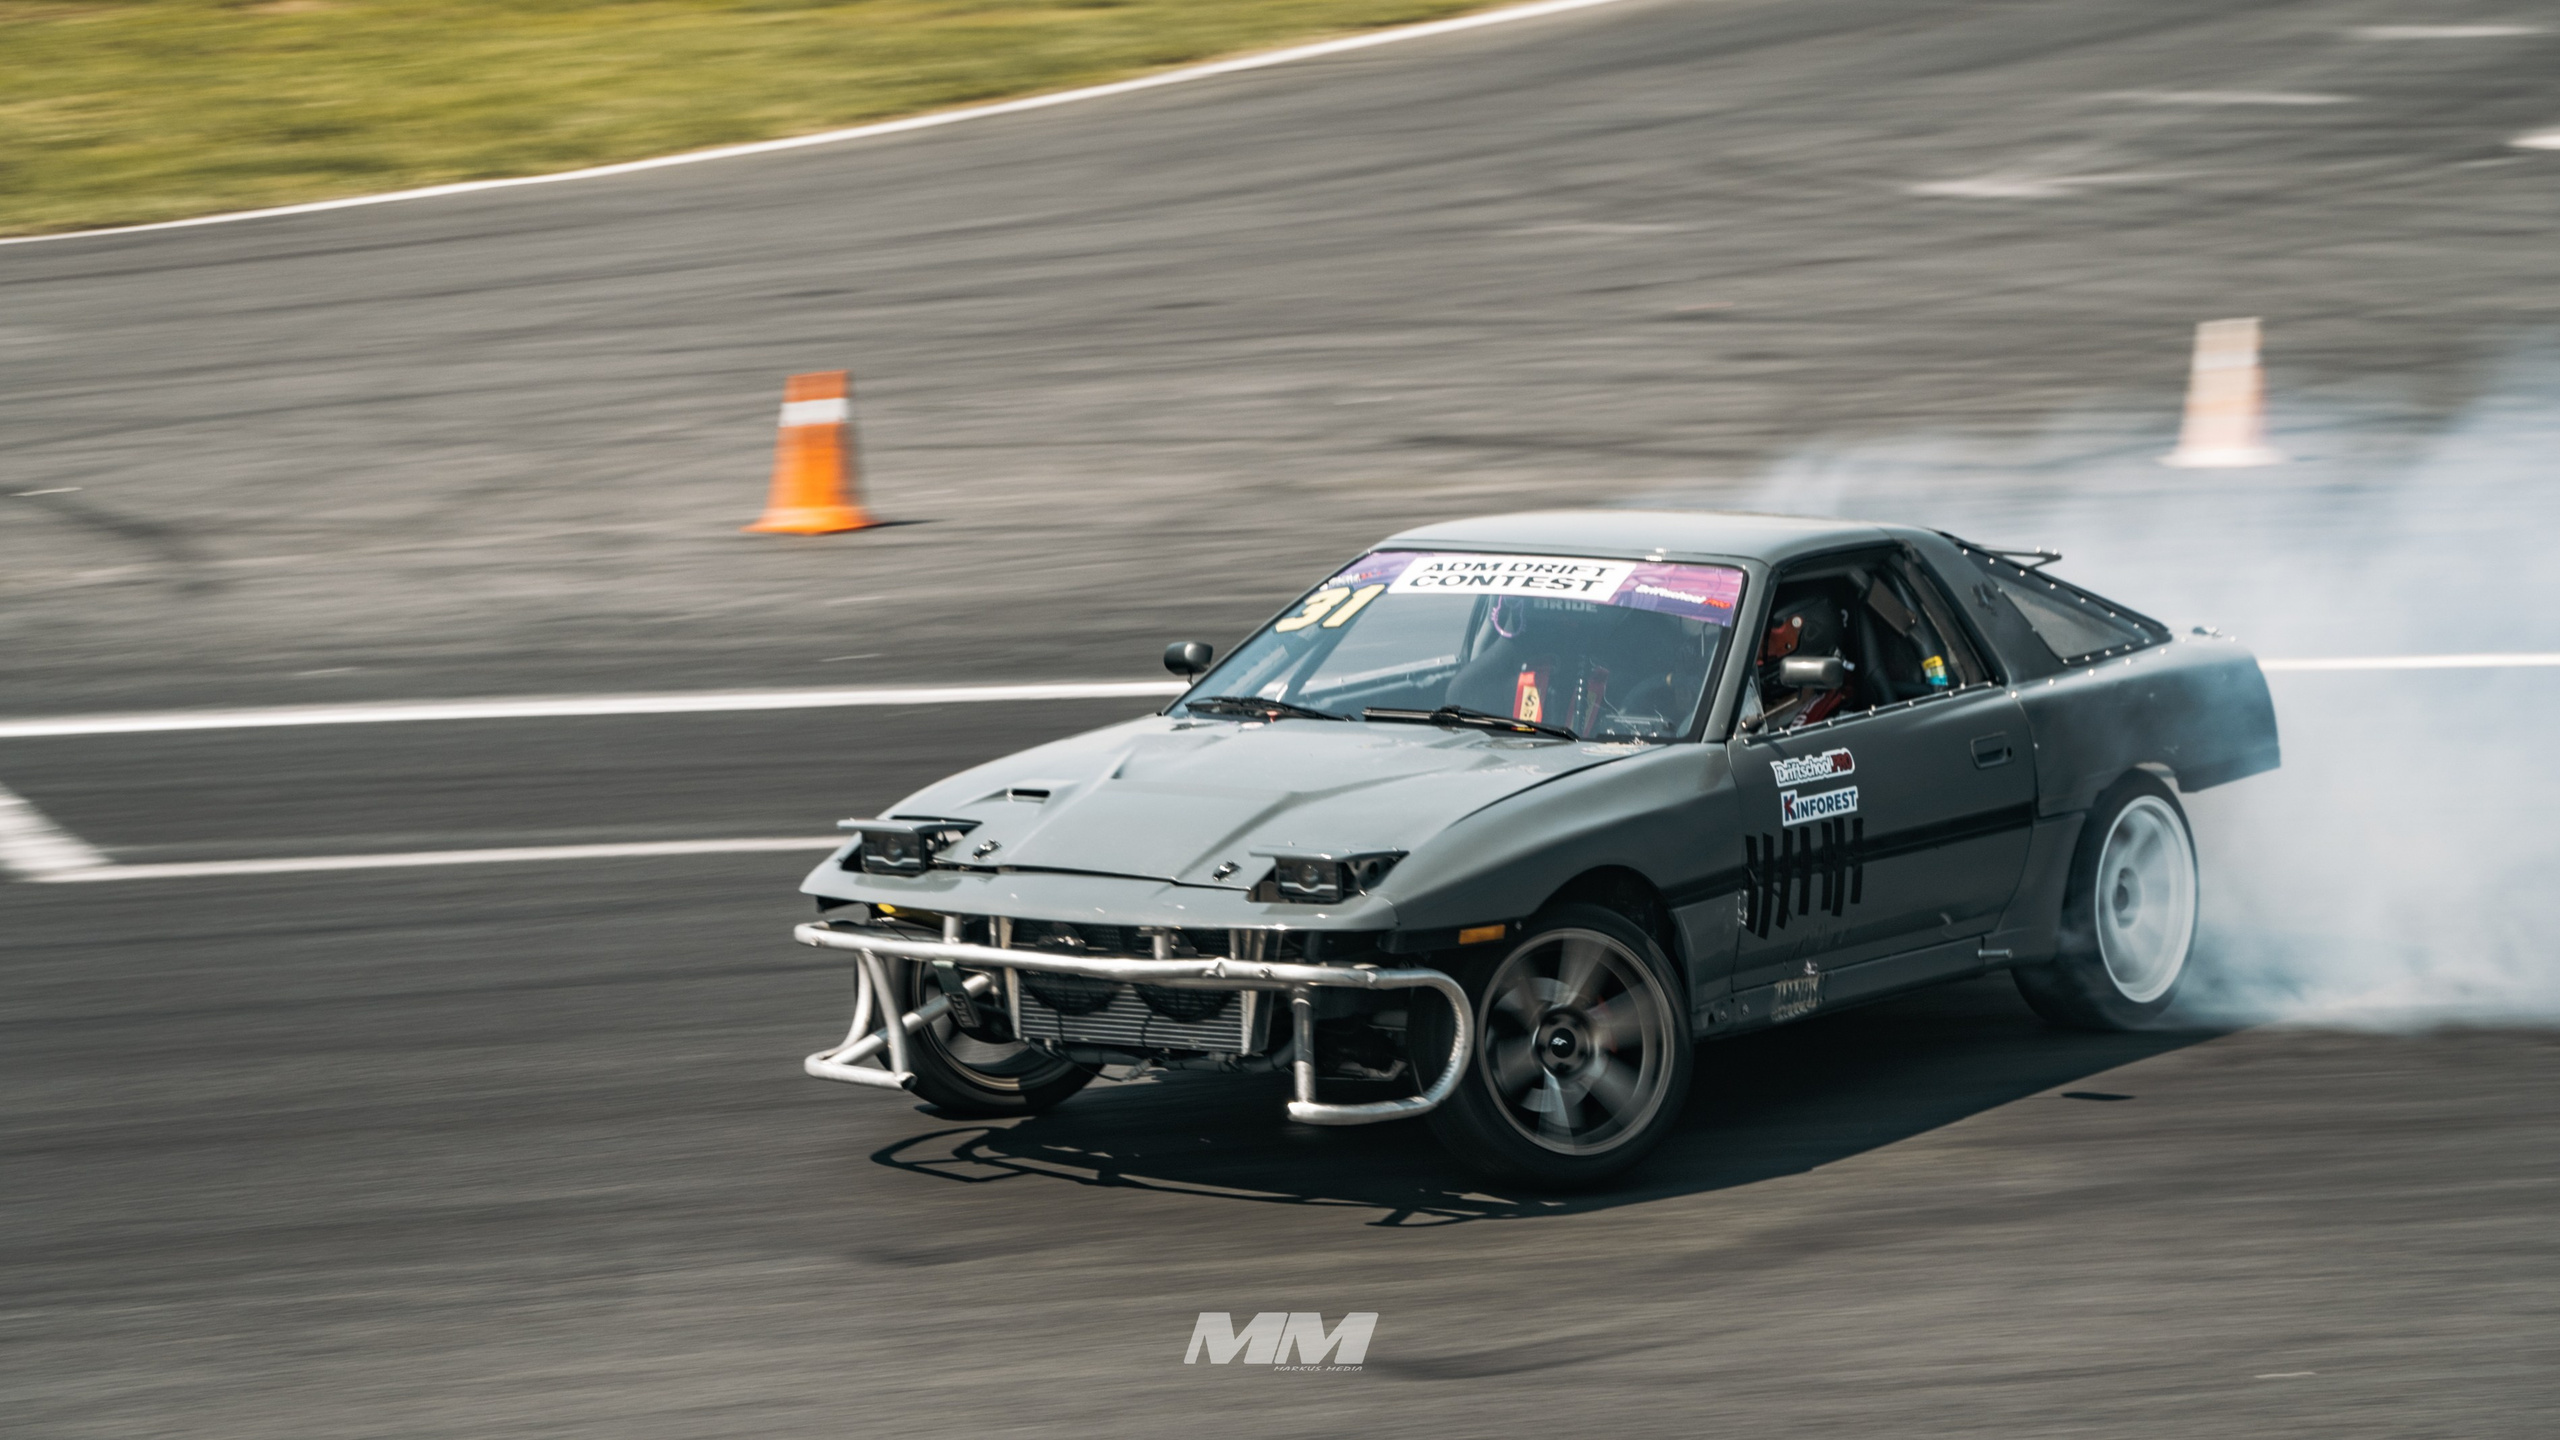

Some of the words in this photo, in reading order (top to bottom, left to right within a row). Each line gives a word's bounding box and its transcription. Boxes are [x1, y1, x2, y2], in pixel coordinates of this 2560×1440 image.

[1423, 562, 1503, 572] ADM
[1509, 562, 1615, 577] DRIFT
[1410, 574, 1604, 592] CONTEST
[1275, 584, 1385, 632] 31
[1783, 790, 1856, 822] KINFOREST
